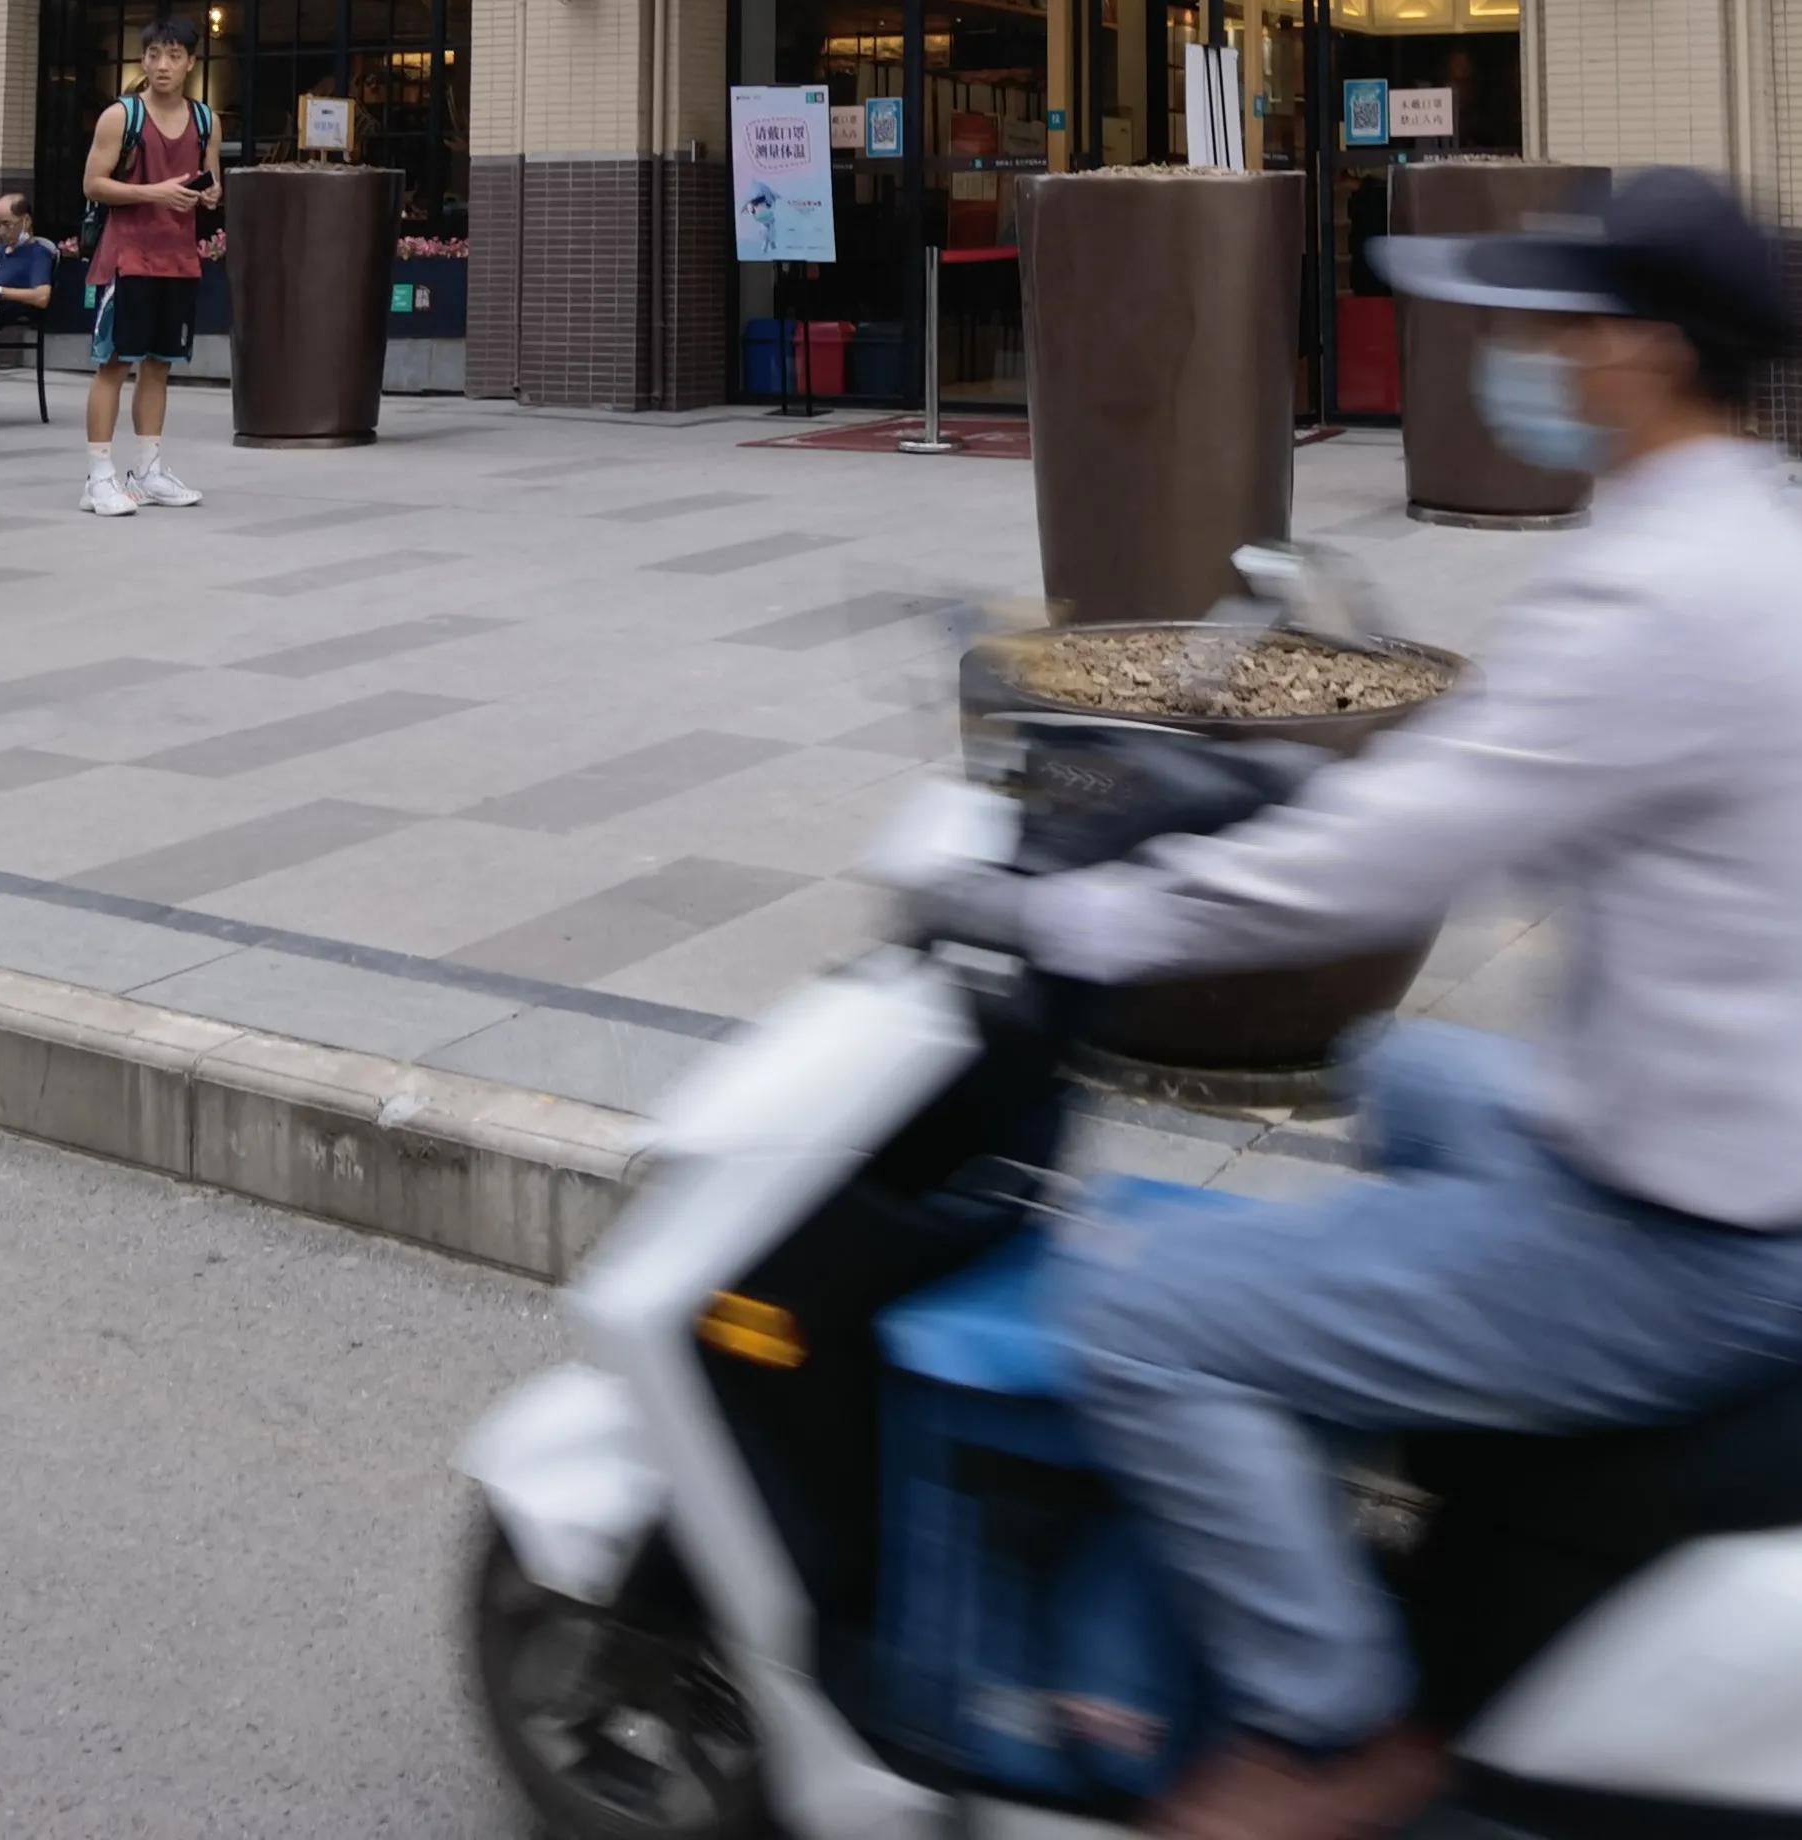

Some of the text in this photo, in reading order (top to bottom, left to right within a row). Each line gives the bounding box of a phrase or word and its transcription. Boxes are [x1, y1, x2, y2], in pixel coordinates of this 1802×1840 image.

[755, 126, 805, 140] 请戴口罩
[755, 144, 805, 160] 测量体温
